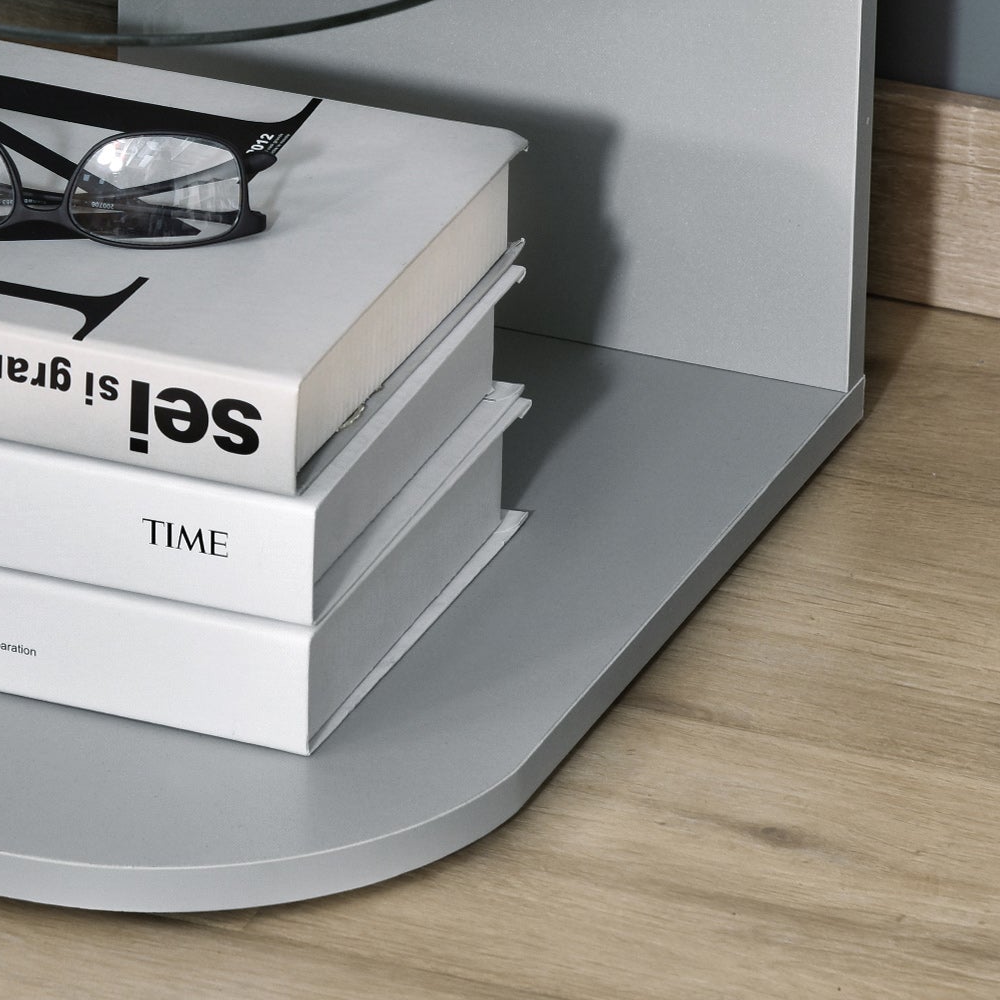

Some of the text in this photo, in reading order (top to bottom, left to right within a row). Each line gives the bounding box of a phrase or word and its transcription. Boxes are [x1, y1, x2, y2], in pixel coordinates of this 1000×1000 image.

[84, 371, 120, 406] si
[129, 380, 262, 456] sei
[142, 517, 229, 558] TIME
